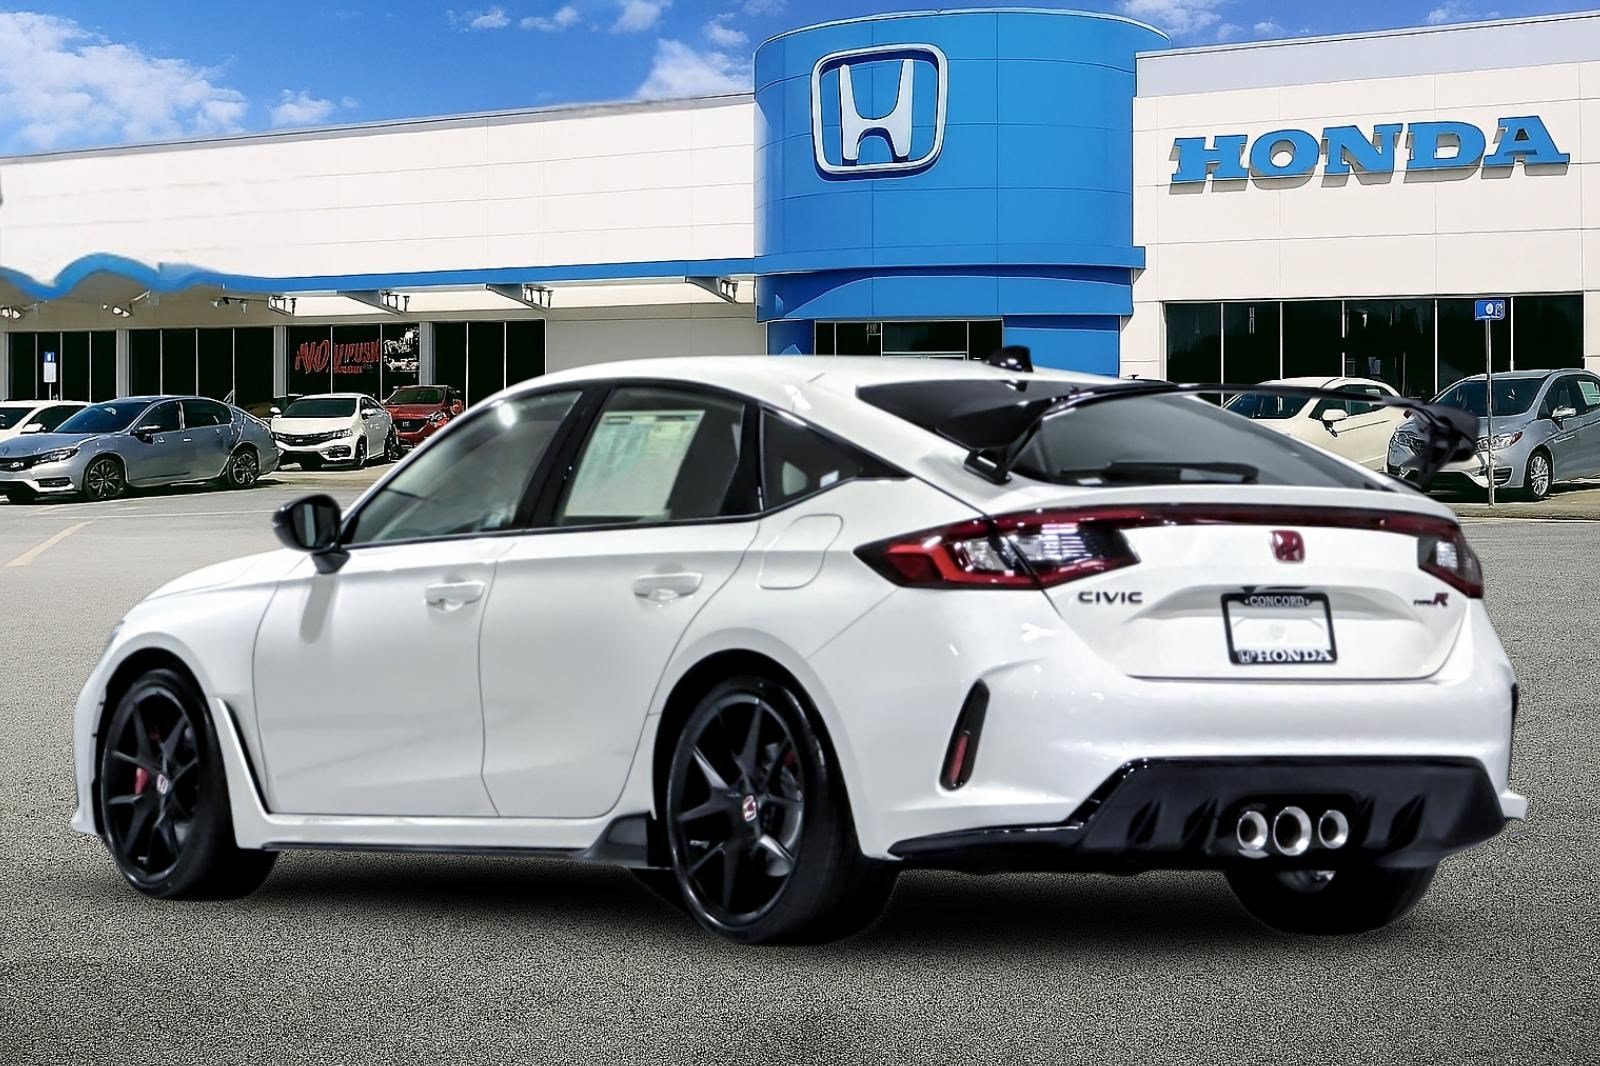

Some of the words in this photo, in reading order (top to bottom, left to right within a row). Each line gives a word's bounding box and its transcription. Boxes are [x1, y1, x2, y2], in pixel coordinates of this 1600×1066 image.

[1171, 115, 1570, 184] HONDA
[1078, 592, 1142, 604] CIVIC
[1249, 596, 1304, 608] CONCORD
[1257, 649, 1333, 662] HONDA
